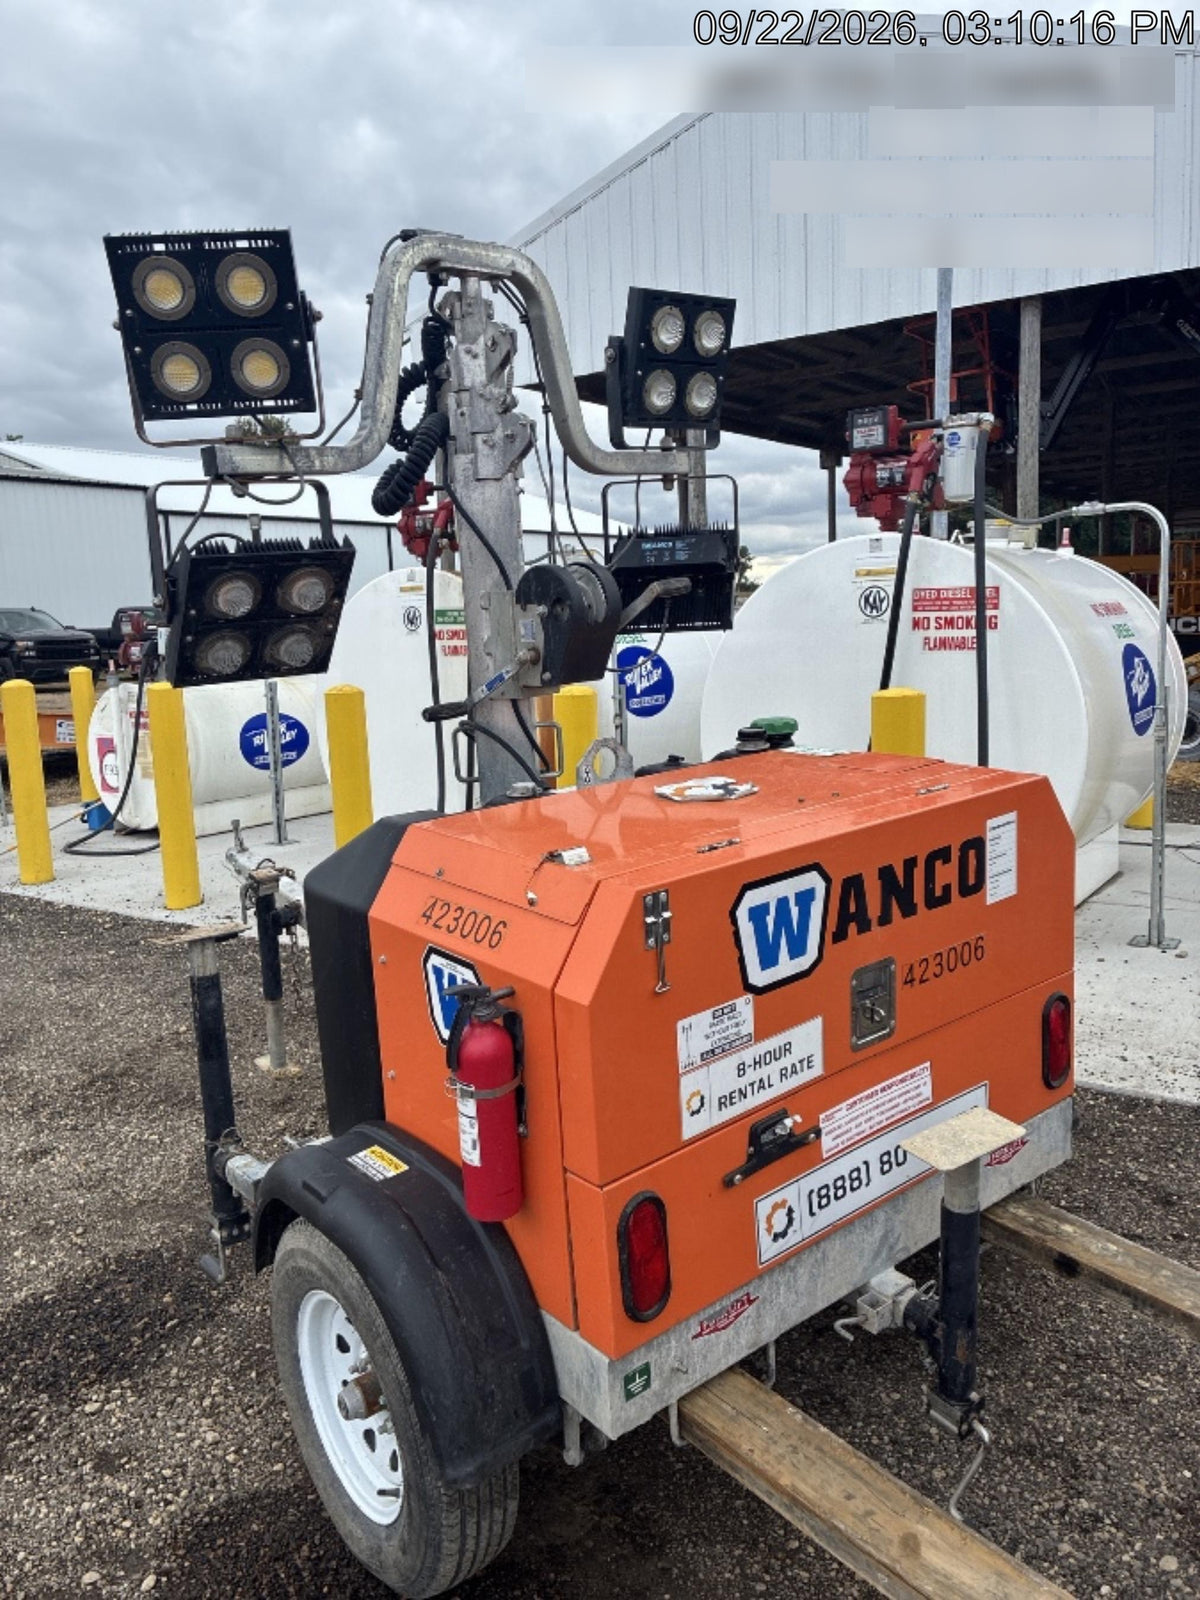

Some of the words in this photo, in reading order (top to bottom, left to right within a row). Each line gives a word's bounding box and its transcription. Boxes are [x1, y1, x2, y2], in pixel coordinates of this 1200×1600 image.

[940, 586, 973, 599] DIESEL
[912, 617, 931, 632] NO
[934, 614, 998, 631] SMOKG
[422, 899, 508, 950] 423006
[747, 836, 986, 972] WANCO
[903, 935, 985, 988] 423006
[717, 1073, 774, 1112] RENTAL
[779, 1053, 815, 1083] RATE
[737, 1041, 792, 1078] 8-HOUR
[807, 1160, 871, 1218] (888)
[879, 1145, 908, 1177] 80
